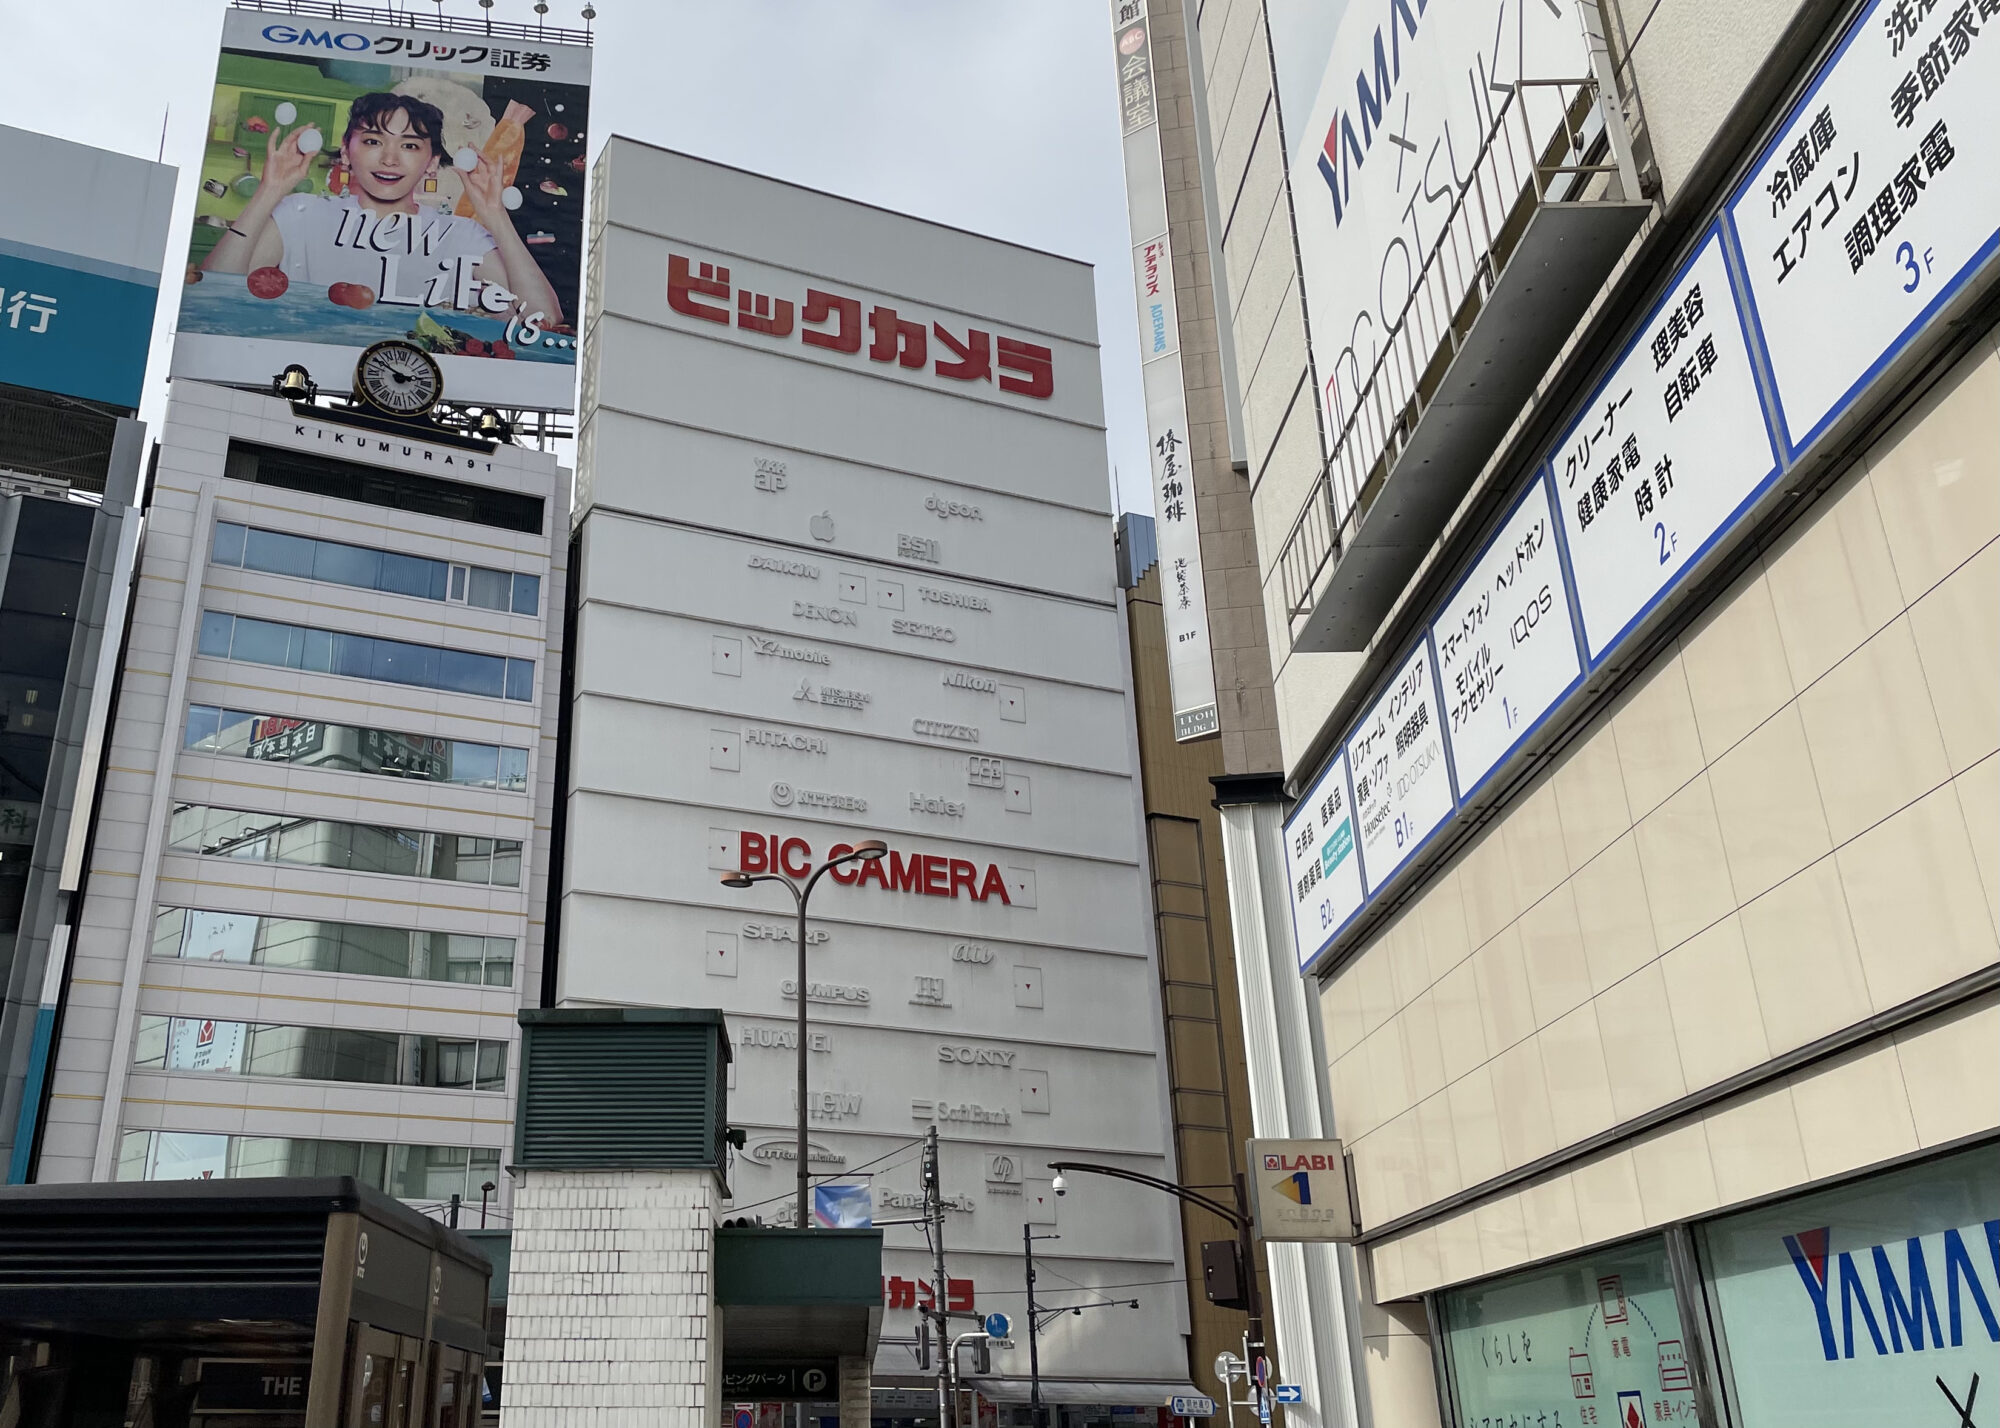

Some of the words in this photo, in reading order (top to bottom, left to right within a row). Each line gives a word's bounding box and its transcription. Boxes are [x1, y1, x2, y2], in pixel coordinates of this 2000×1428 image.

[261, 24, 551, 73] GMOクリック証券
[1121, 55, 1153, 131] 会議室
[1317, 0, 1428, 229] YAMA
[1766, 104, 1837, 218] 冷蔵庫
[1772, 151, 1859, 285] エアコン
[1843, 118, 1956, 275] 調理家電
[334, 207, 454, 257] new
[1143, 244, 1161, 299] アデランス
[0, 287, 58, 334] 行
[667, 253, 1053, 400] ビックカメラ
[1150, 303, 1167, 353] ADERANS
[1651, 282, 1705, 374] 理美容
[1664, 332, 1719, 424] 自転車
[1566, 387, 1634, 489] クリーナー
[1155, 428, 1187, 523] 椿屋珈琲
[1577, 432, 1641, 532] 健康家電
[924, 493, 984, 522] dyson
[747, 554, 820, 580] DAIKIN
[1496, 518, 1545, 592] ヘッドホン
[792, 600, 858, 627] DENON
[917, 585, 992, 614] TOSHIBA
[1510, 584, 1552, 650] IQOS
[891, 618, 957, 643] SEIKO
[1178, 630, 1197, 643] B1F
[1442, 590, 1490, 669] スマートフォン
[942, 671, 997, 694] Nikon
[1388, 658, 1424, 723] インテリア
[1456, 643, 1491, 696] モバイル
[820, 685, 873, 704] MITSUBISHI
[820, 696, 865, 711] ELECTRIC
[1179, 709, 1215, 726] ITOH
[1451, 664, 1504, 734] アクセサリー
[744, 728, 829, 756] HITACHI
[912, 718, 980, 744] CITIZEN
[1352, 716, 1386, 772] リフォーム
[1395, 701, 1429, 760] 照明器具
[797, 789, 868, 813] NTT東日本
[909, 791, 966, 818] Haier
[740, 830, 812, 878] BIC
[828, 843, 1011, 905] CAMERA
[952, 942, 995, 965] au
[781, 979, 872, 1004] OYMPUS
[937, 1044, 1016, 1068] SONY
[937, 1101, 1012, 1127] SoftBank
[1280, 1154, 1335, 1171] LABI
[878, 1187, 976, 1215] Panaic
[1782, 1219, 2000, 1361] YAMA
[1480, 1330, 1532, 1369] くらしを
[261, 1376, 303, 1396] THE
[1579, 1404, 1598, 1425] 住宅
